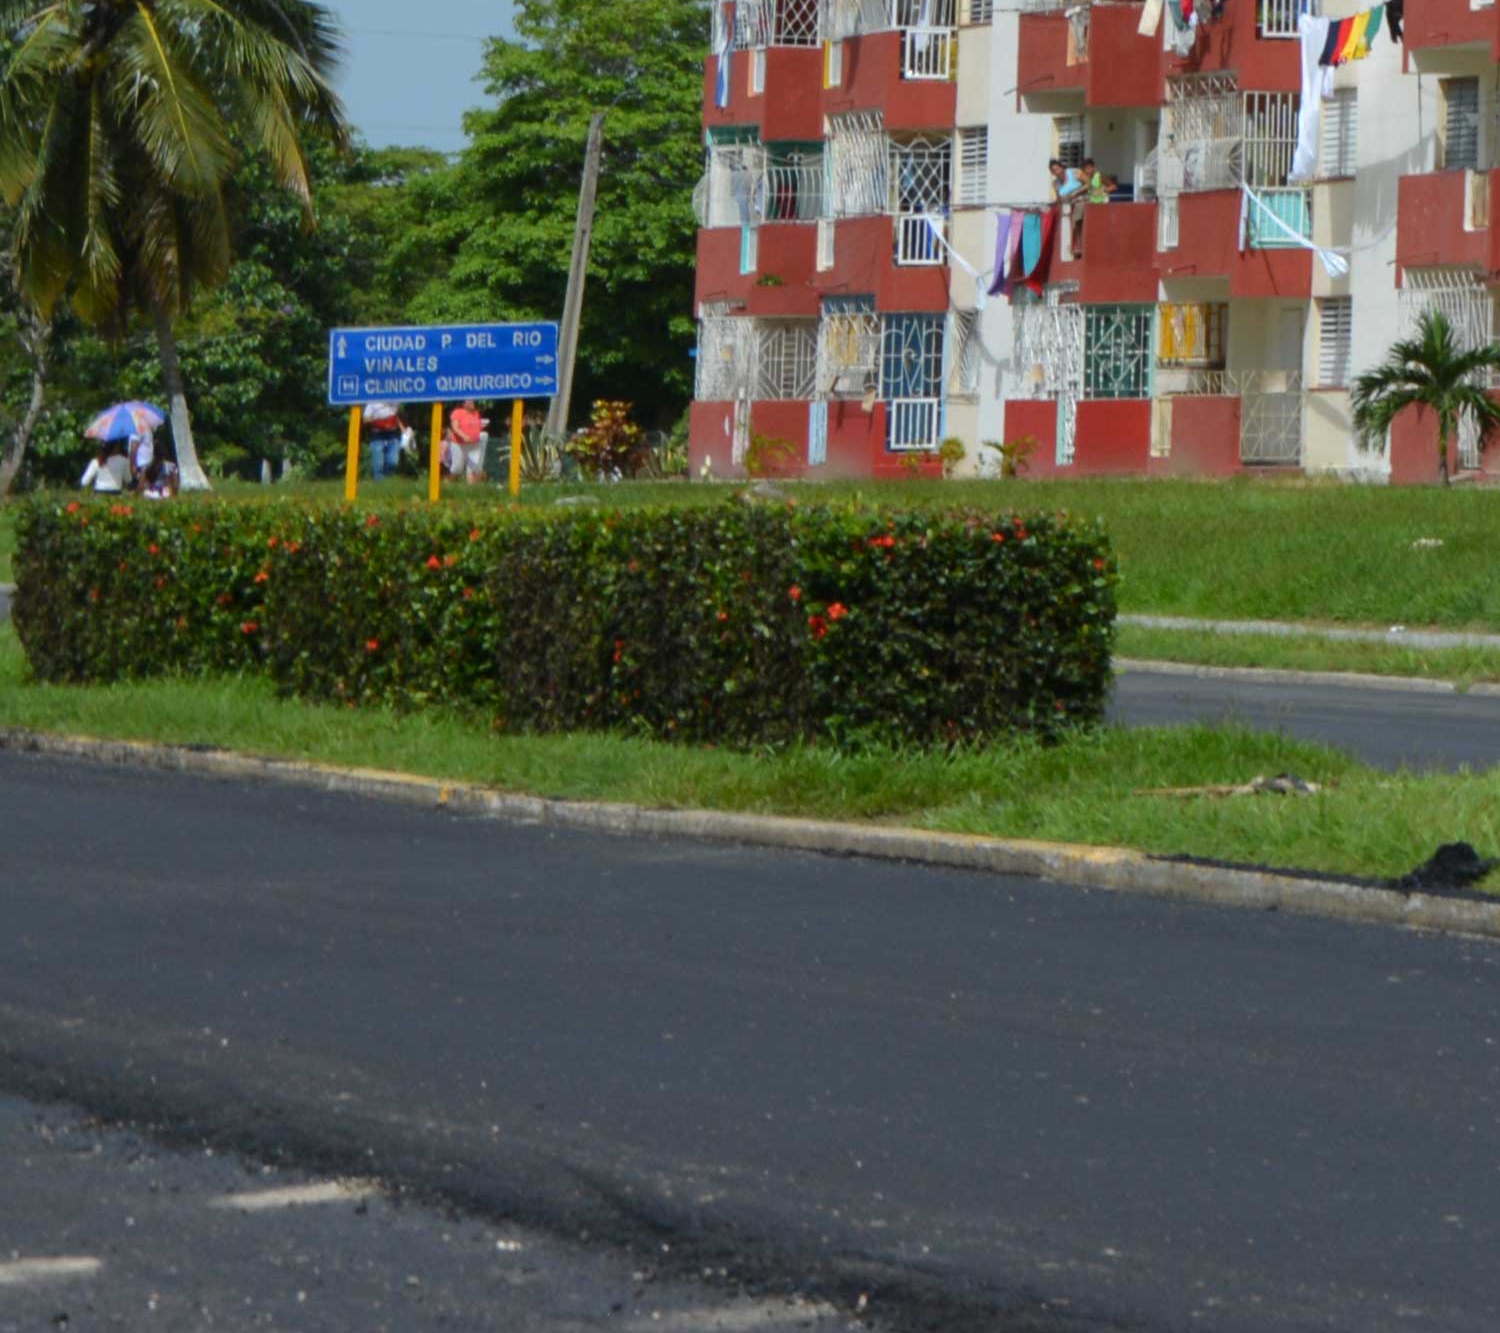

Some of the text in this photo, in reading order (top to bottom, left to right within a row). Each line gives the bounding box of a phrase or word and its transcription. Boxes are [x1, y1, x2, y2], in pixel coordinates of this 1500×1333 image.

[365, 335, 426, 352] CIUDAD
[466, 332, 496, 349] DEL
[512, 330, 542, 347] RIO
[365, 354, 438, 373] VIÑALES
[364, 373, 532, 394] CLINICO QUIRURGICO
